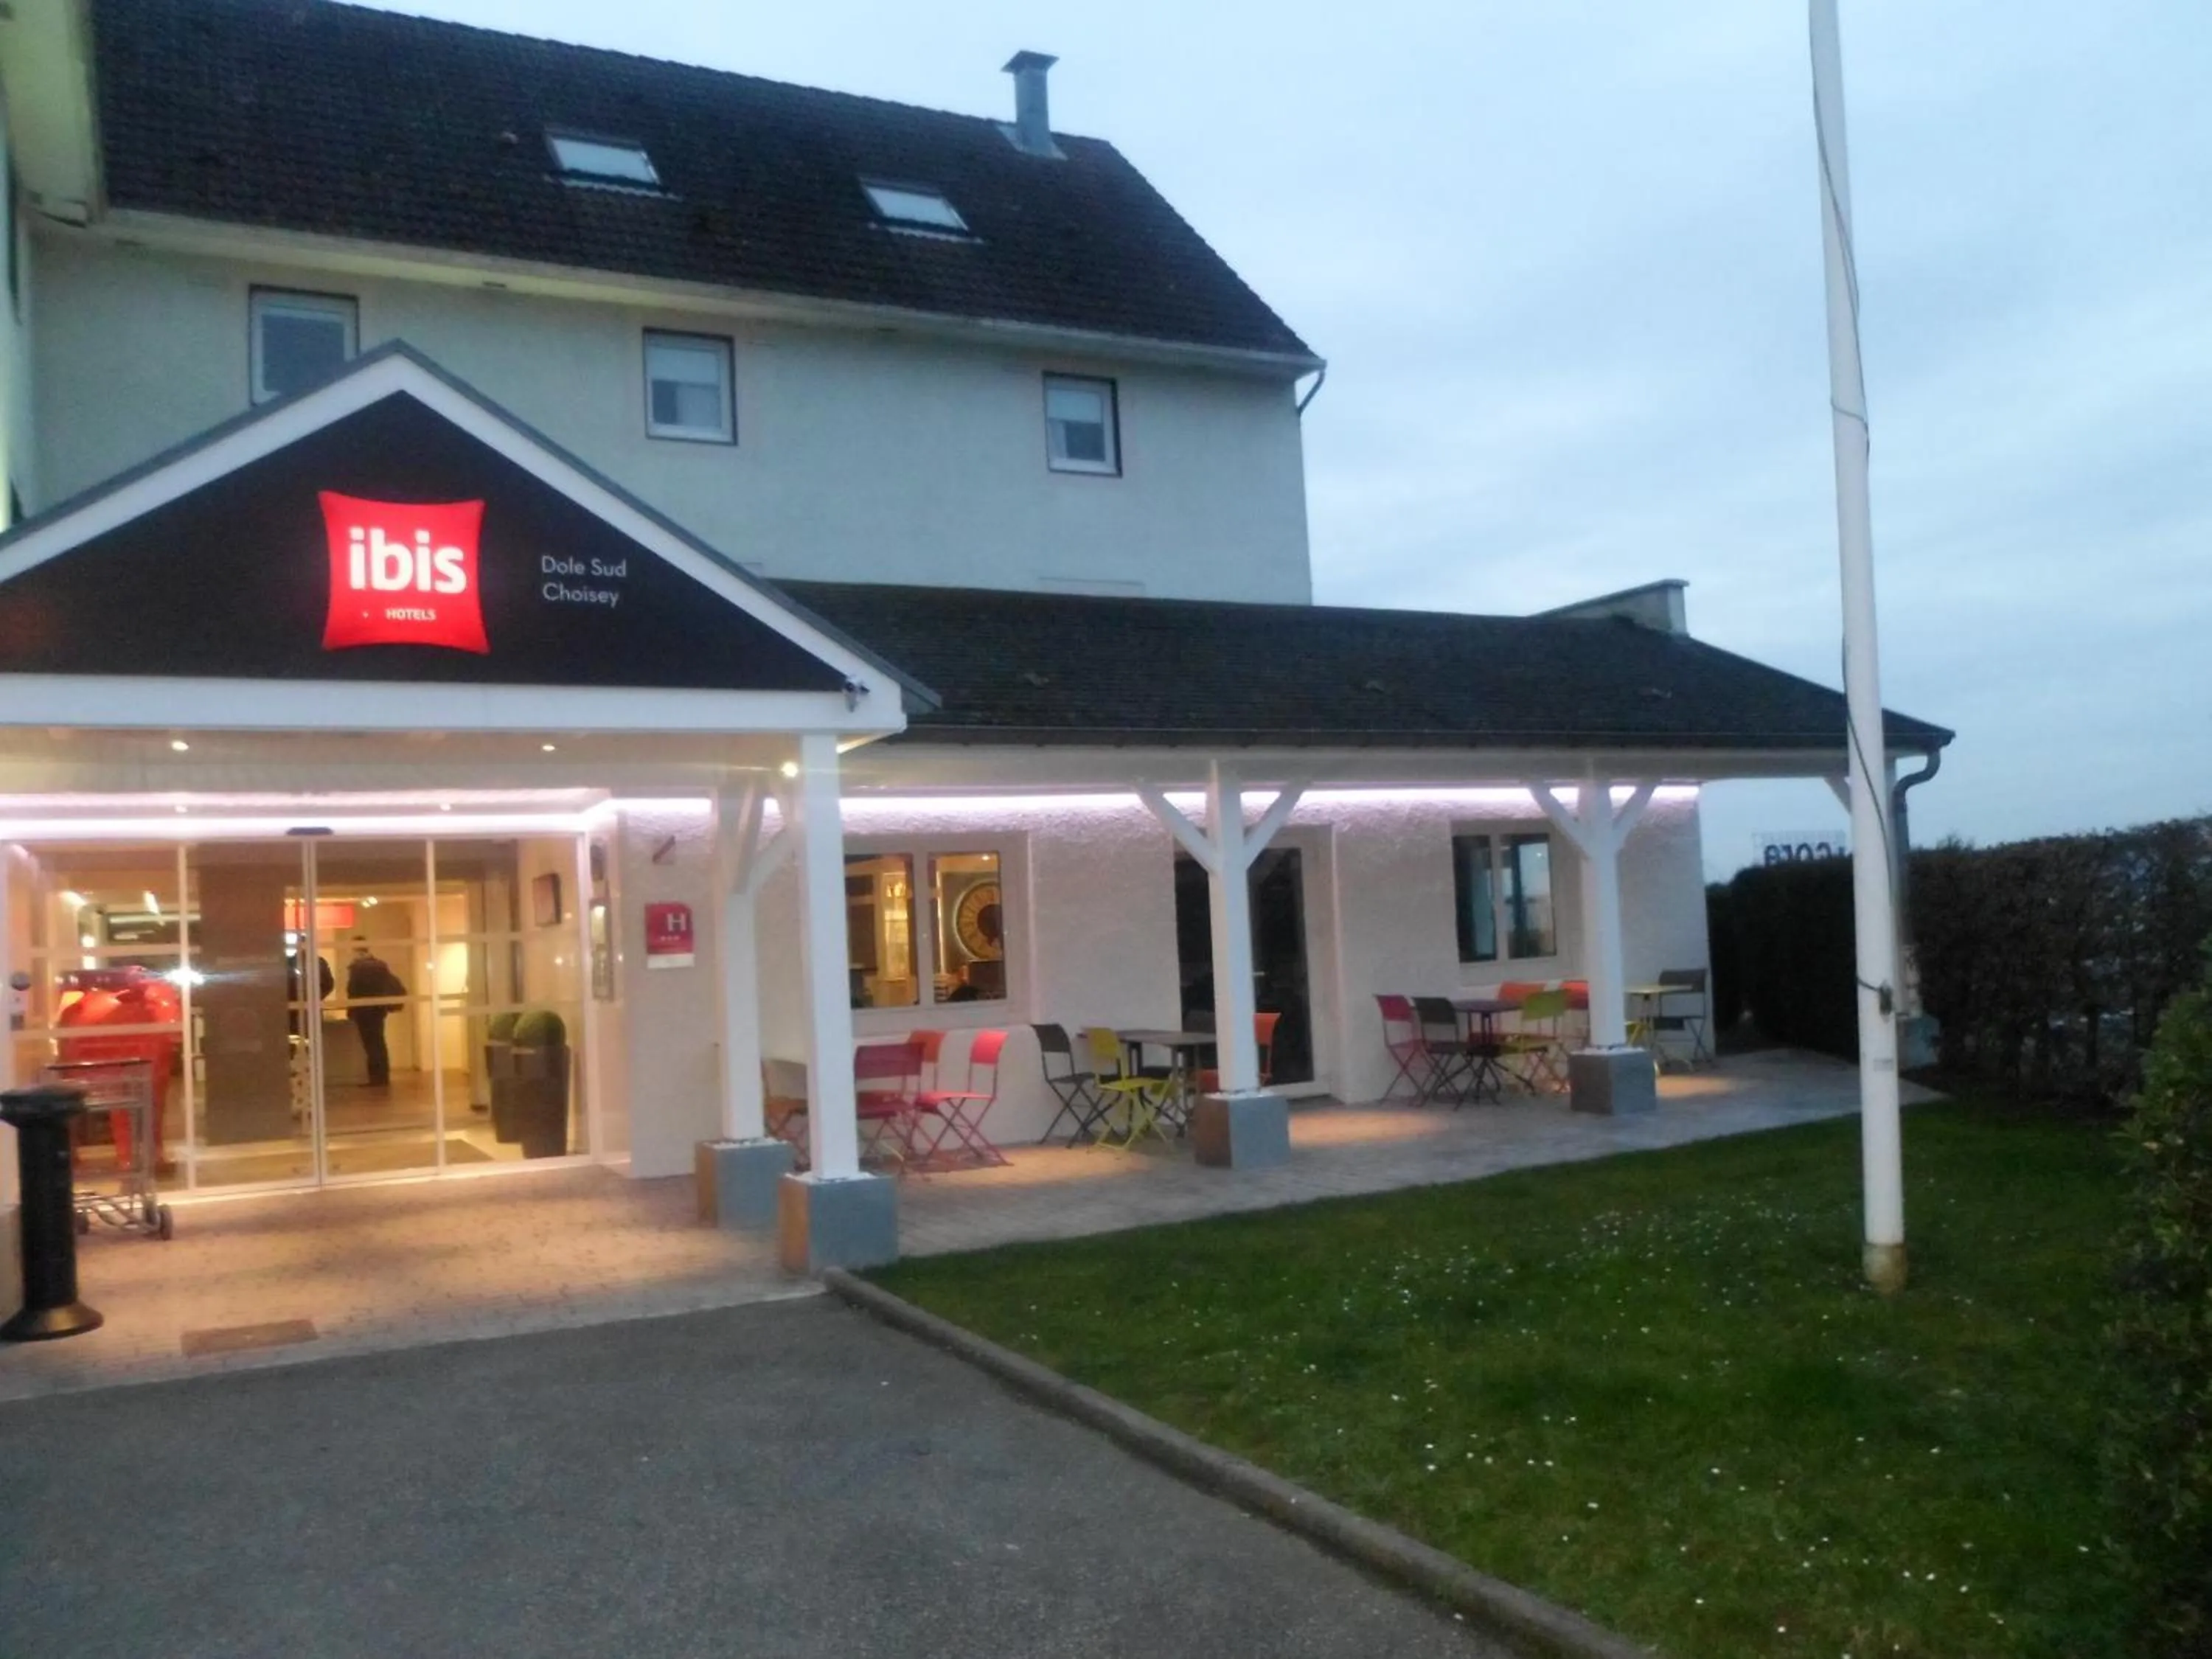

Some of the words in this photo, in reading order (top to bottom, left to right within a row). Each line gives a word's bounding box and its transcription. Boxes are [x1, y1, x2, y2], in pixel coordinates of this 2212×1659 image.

[349, 526, 467, 594] ibis
[542, 555, 585, 574] Dole
[590, 558, 627, 577] Sud
[543, 582, 619, 608] Choisey
[386, 608, 437, 621] HOTELS
[667, 913, 686, 931] H
